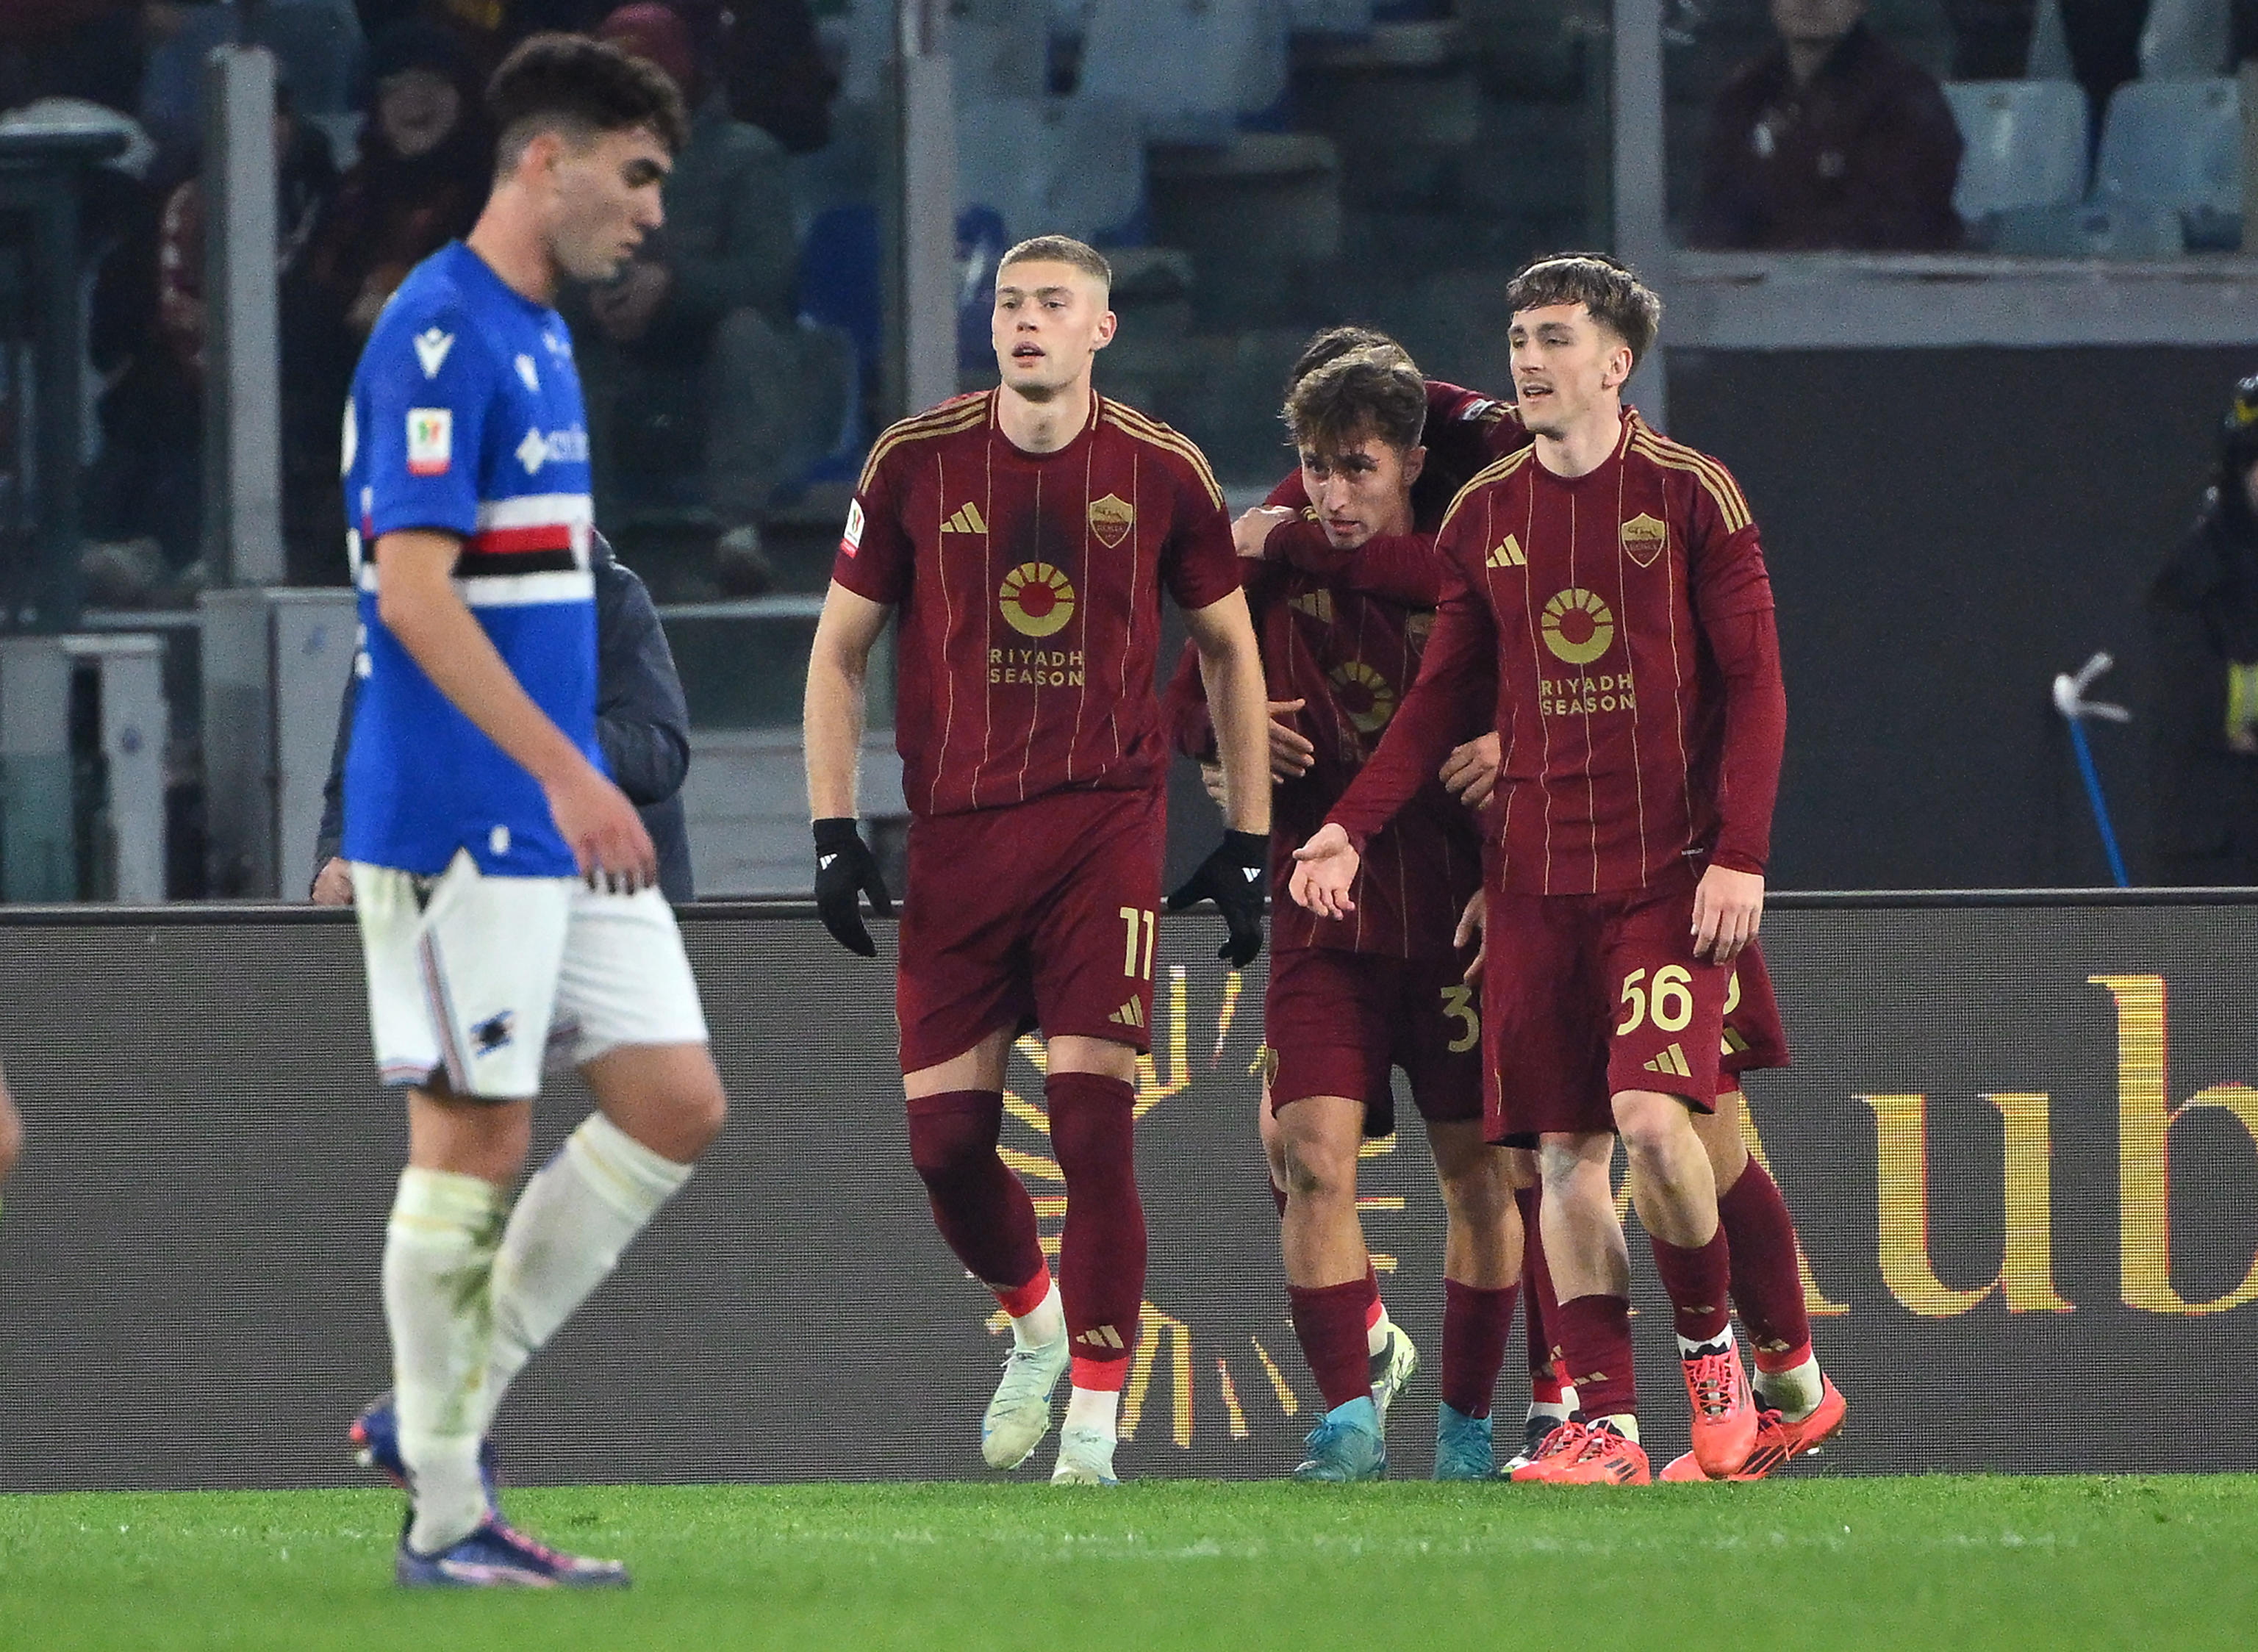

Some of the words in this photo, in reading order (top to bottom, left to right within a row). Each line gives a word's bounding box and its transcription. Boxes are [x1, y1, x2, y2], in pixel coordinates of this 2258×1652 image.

[989, 648, 1083, 667] RIYADH
[989, 668, 1084, 686] SEASON
[1541, 673, 1632, 696] RIYADH
[1542, 694, 1635, 716] SEASON
[1119, 906, 1155, 981] 11
[1616, 964, 1693, 1036] 56
[1613, 974, 2258, 1318] ub
